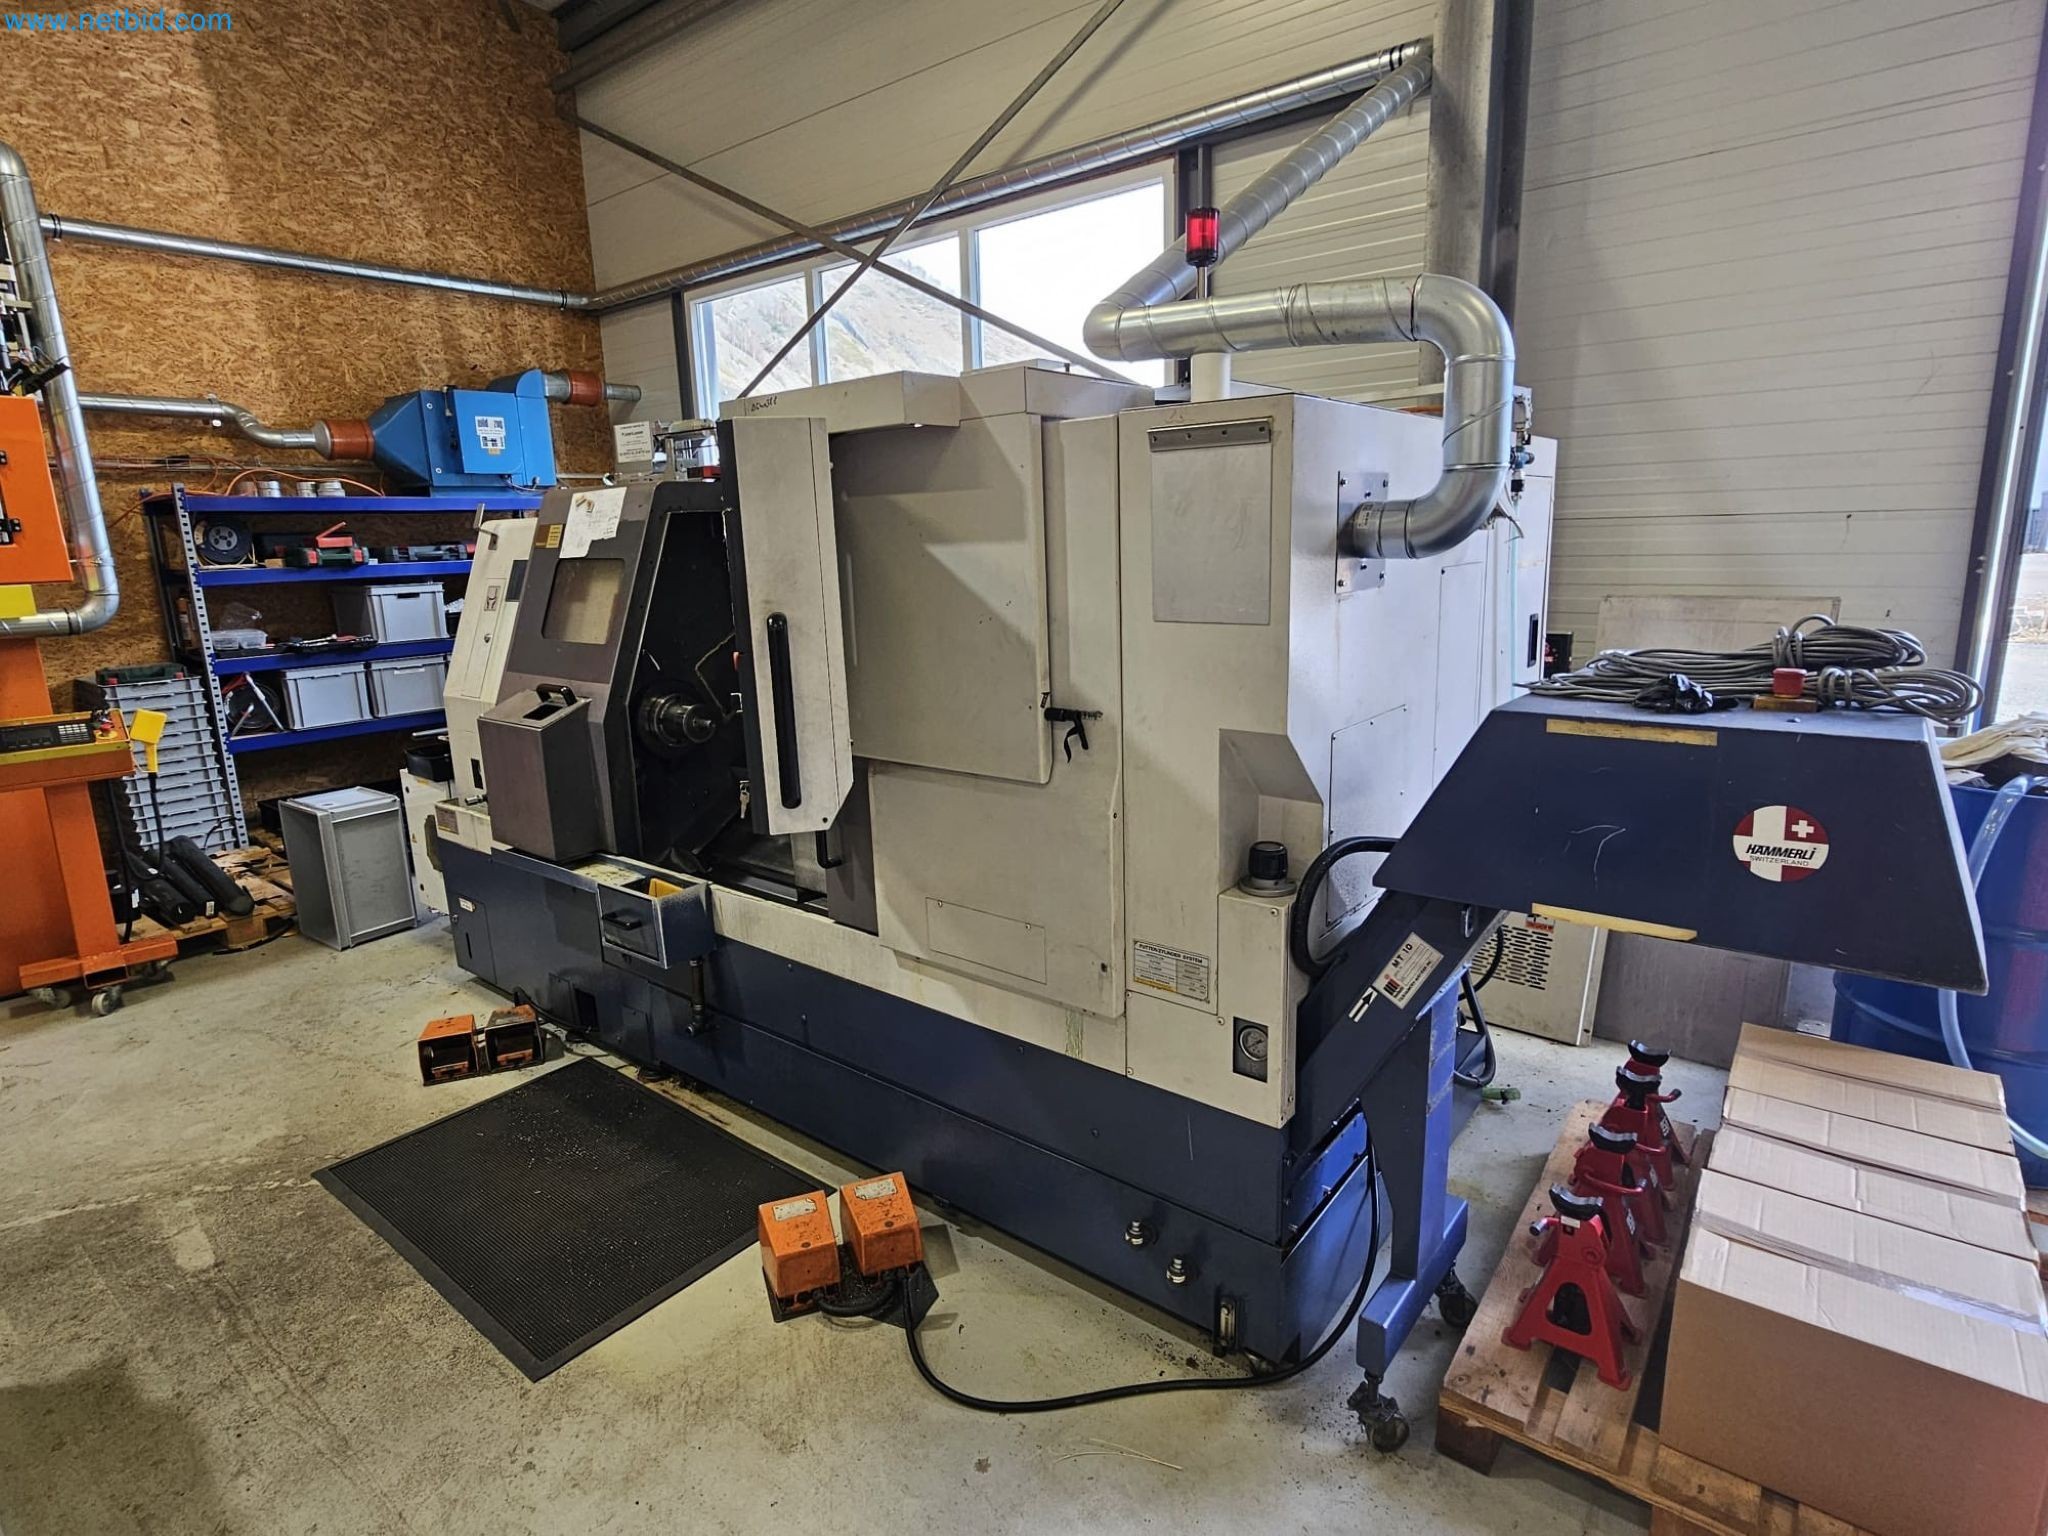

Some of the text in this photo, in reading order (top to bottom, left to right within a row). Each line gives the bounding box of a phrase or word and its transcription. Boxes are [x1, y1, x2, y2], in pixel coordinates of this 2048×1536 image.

[1749, 855, 1809, 867] SWITZERLAND
[1391, 943, 1413, 969] MT 10
